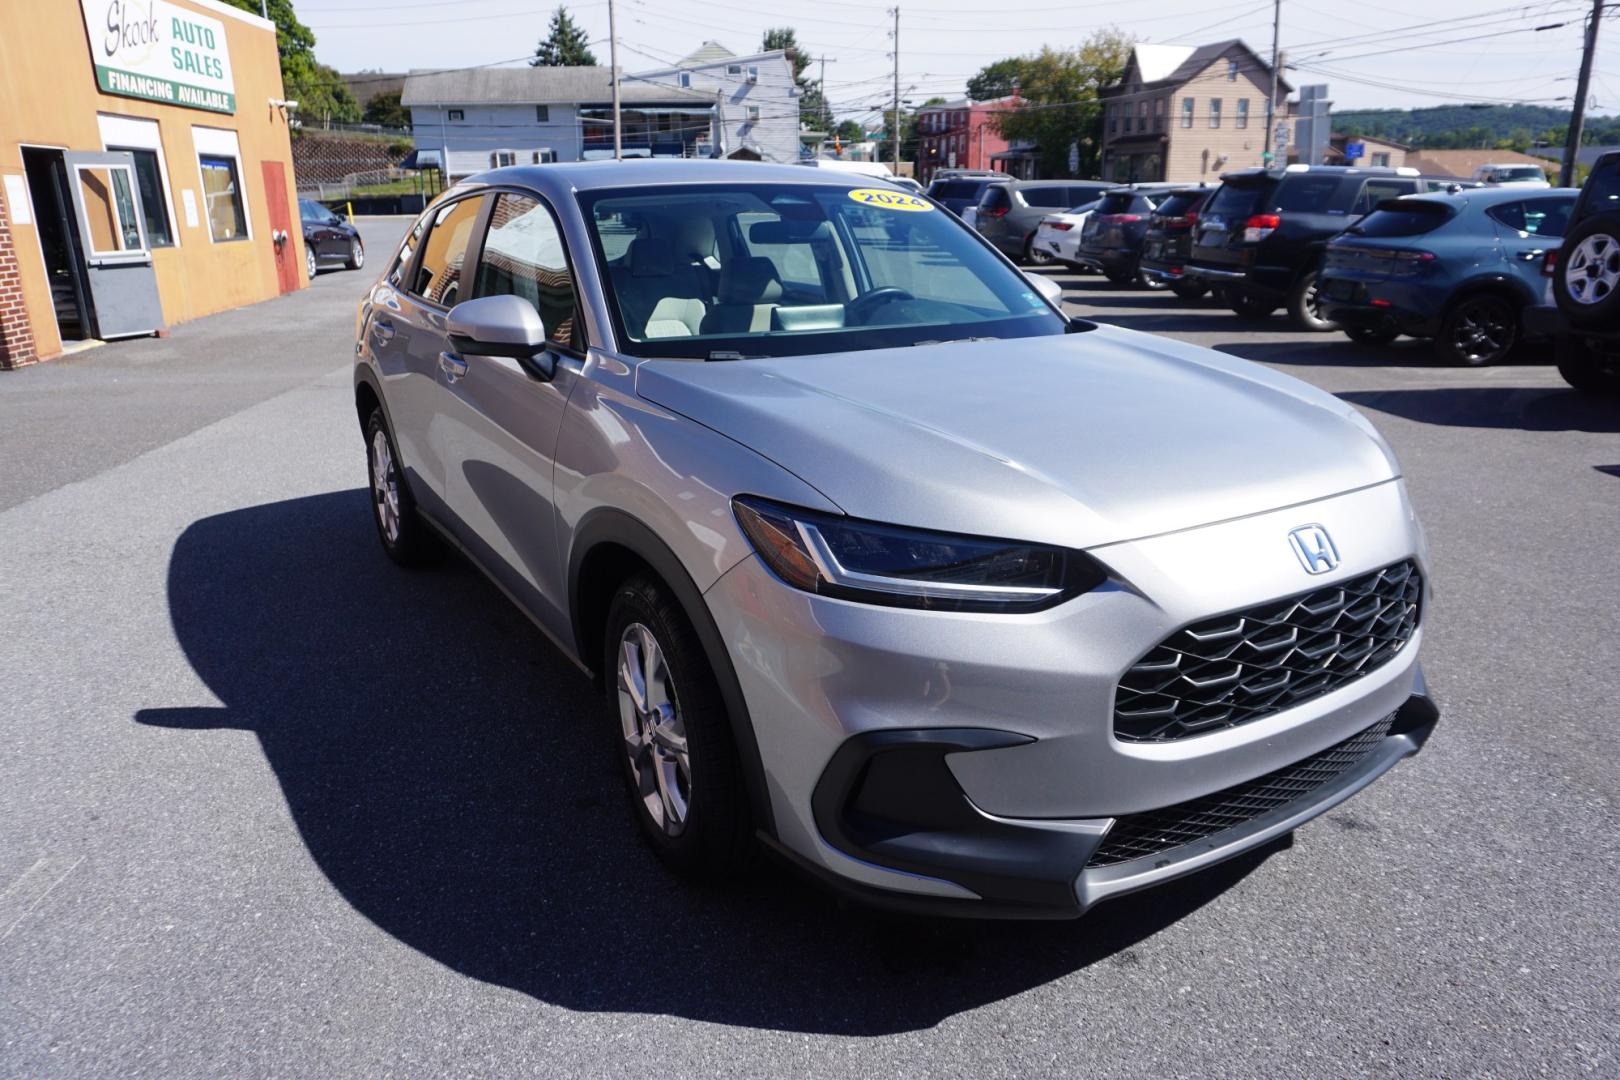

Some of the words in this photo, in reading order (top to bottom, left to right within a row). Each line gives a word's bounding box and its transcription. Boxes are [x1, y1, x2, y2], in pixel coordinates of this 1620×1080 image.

[105, 0, 159, 57] Skook
[171, 16, 215, 50] AUTO
[171, 46, 223, 79] SALES
[108, 71, 173, 99] FINANCING
[178, 87, 229, 110] AVAILABLE
[859, 192, 925, 208] 2024
